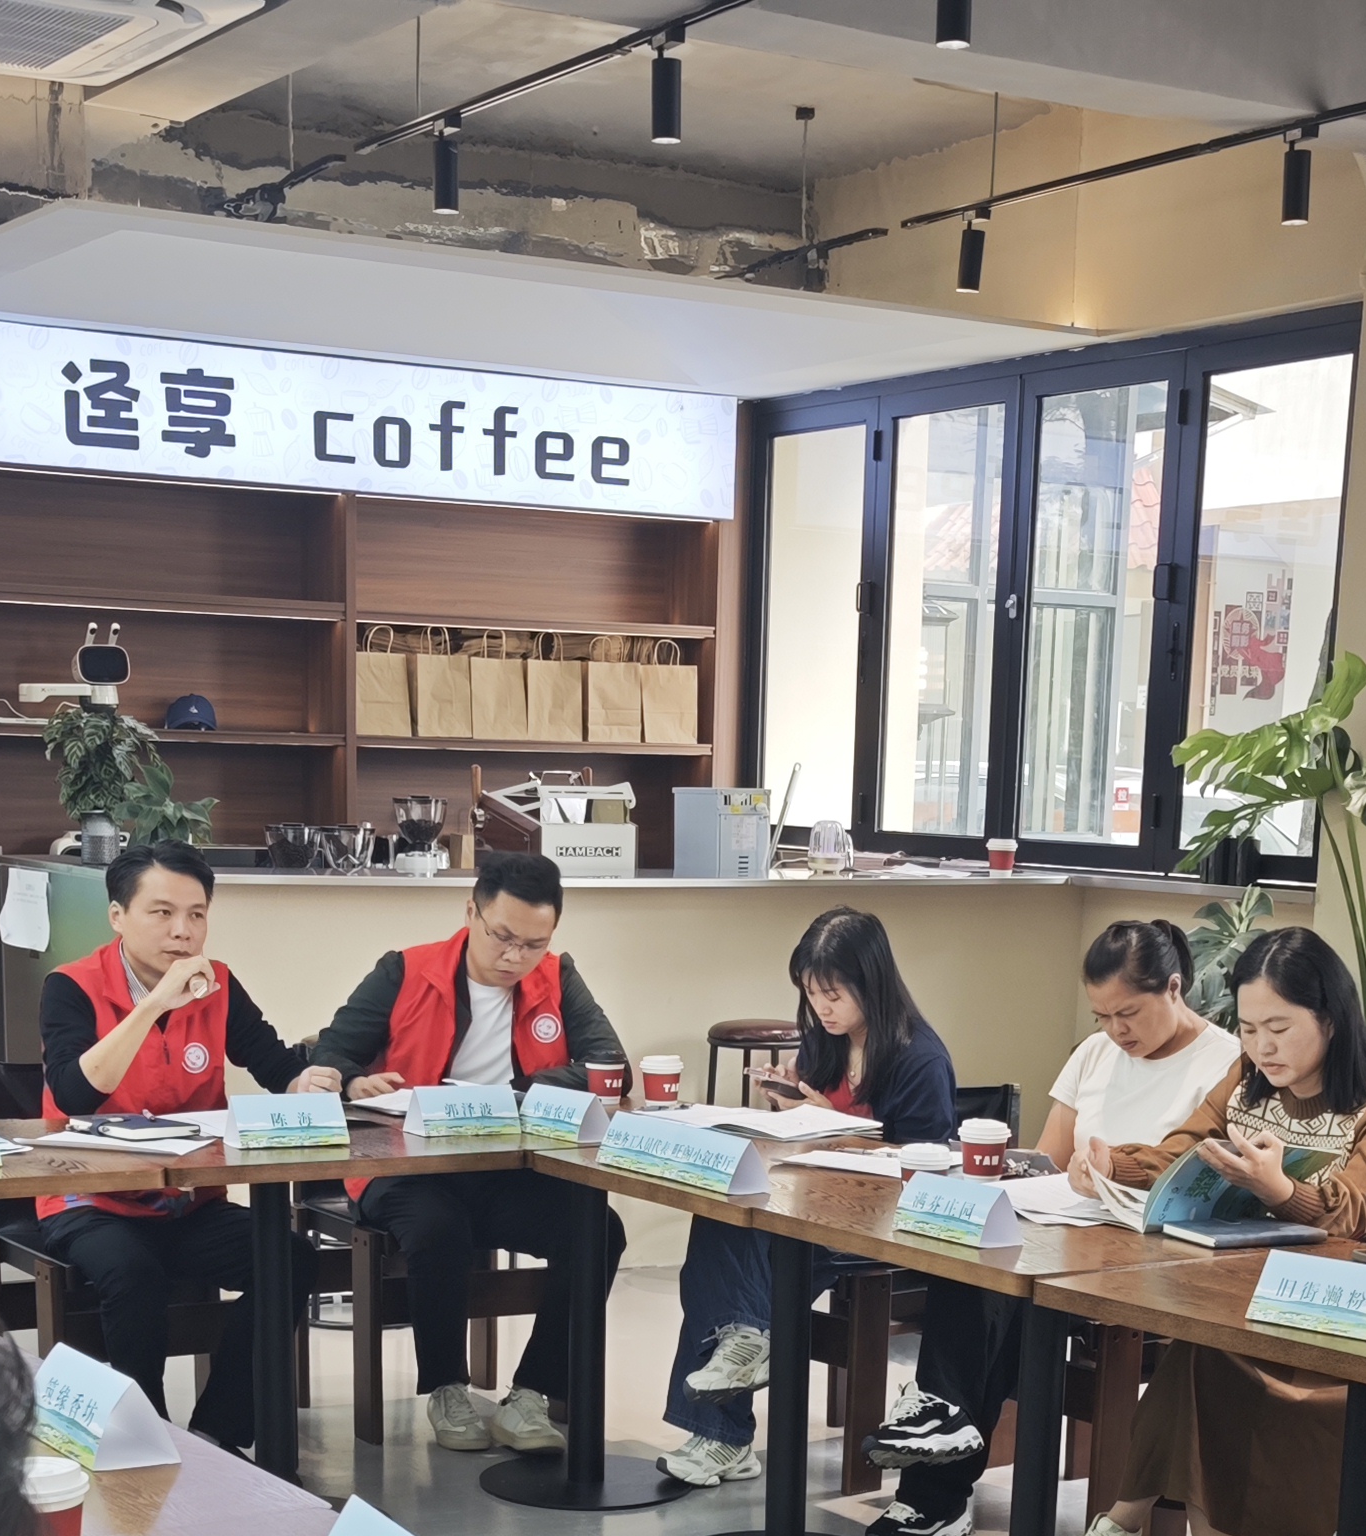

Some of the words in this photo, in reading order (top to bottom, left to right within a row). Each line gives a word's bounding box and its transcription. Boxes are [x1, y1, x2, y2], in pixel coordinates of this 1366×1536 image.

[313, 400, 632, 487] coffee
[556, 845, 622, 857] HAMBACH
[1275, 1277, 1366, 1310] 旧街濑粉
